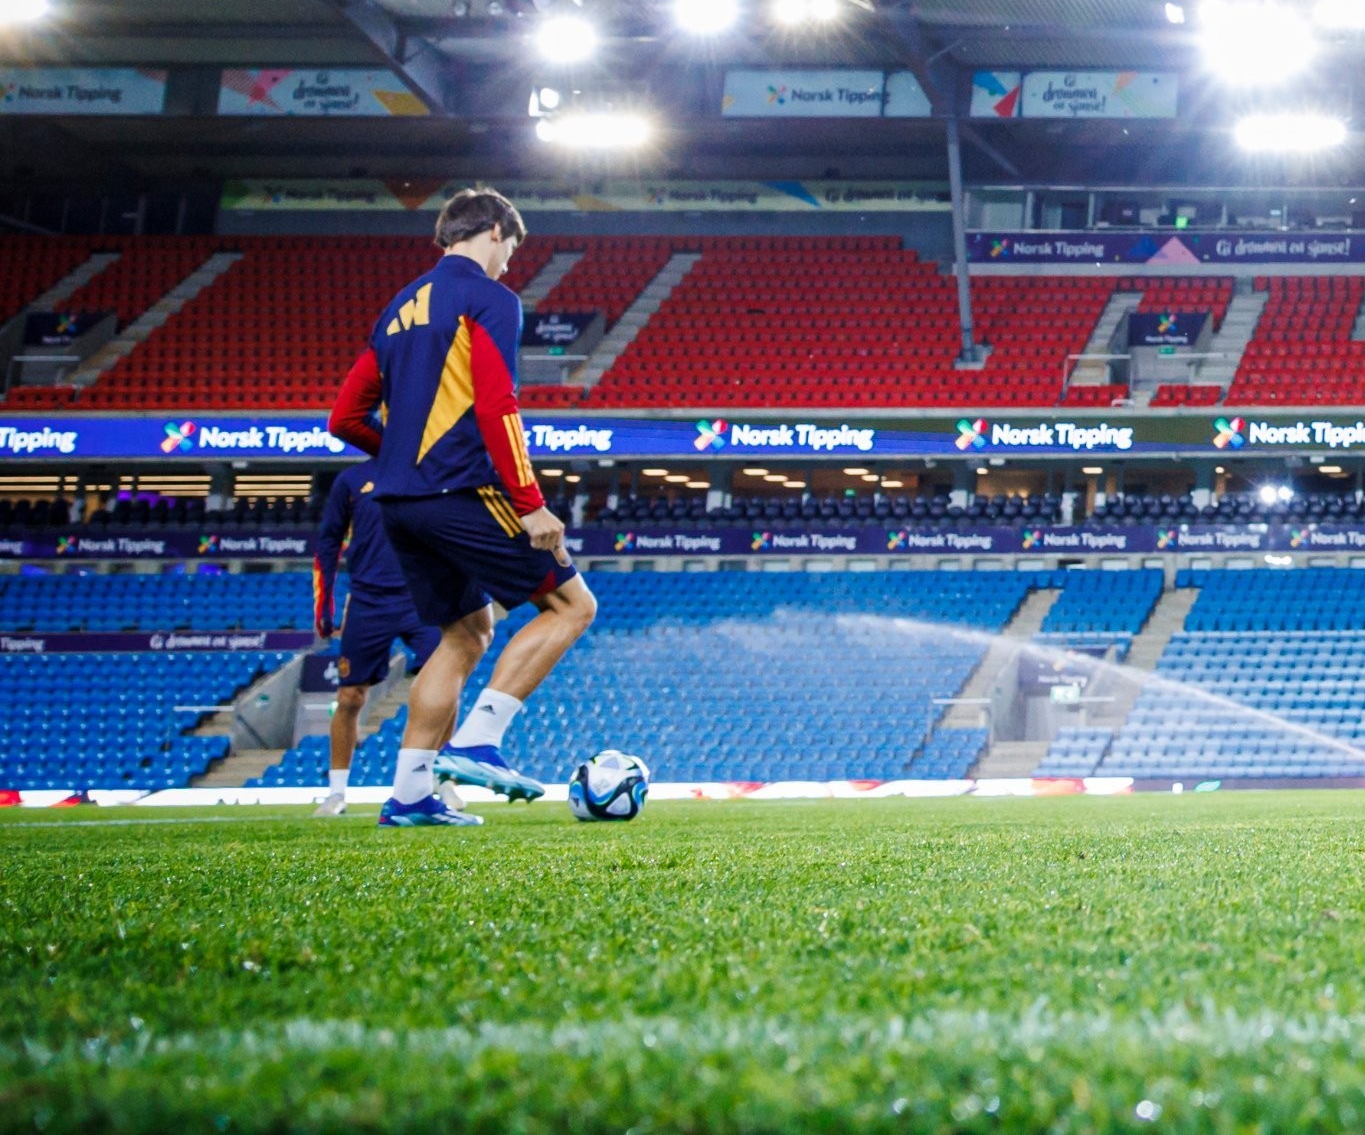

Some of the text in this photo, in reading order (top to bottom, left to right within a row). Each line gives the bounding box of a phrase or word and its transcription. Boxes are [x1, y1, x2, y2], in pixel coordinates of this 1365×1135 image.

[18, 85, 122, 102] Norsk Tipping
[791, 87, 889, 104] Norsk Tipping
[1013, 241, 1104, 259] Norsk Tipping
[0, 427, 78, 453] Tipping
[199, 426, 345, 453] Norsk Tipping
[532, 426, 613, 451] Tipping
[731, 424, 874, 450] Norsk Tipping
[992, 423, 1133, 449] Norsk Tipping
[1250, 423, 1309, 444] Norsk
[220, 537, 307, 554] Norsk Tipping
[637, 536, 720, 551] Norsk Tipping
[773, 536, 856, 552] Norsk Tipping
[909, 535, 992, 551] Norsk Tipping
[1044, 533, 1126, 550] Norsk Tipping
[1178, 531, 1259, 547] Norsk Tipping
[1311, 532, 1346, 544] Norsk
[79, 539, 164, 555] Norsk Tipping
[0, 637, 44, 652] Tipping
